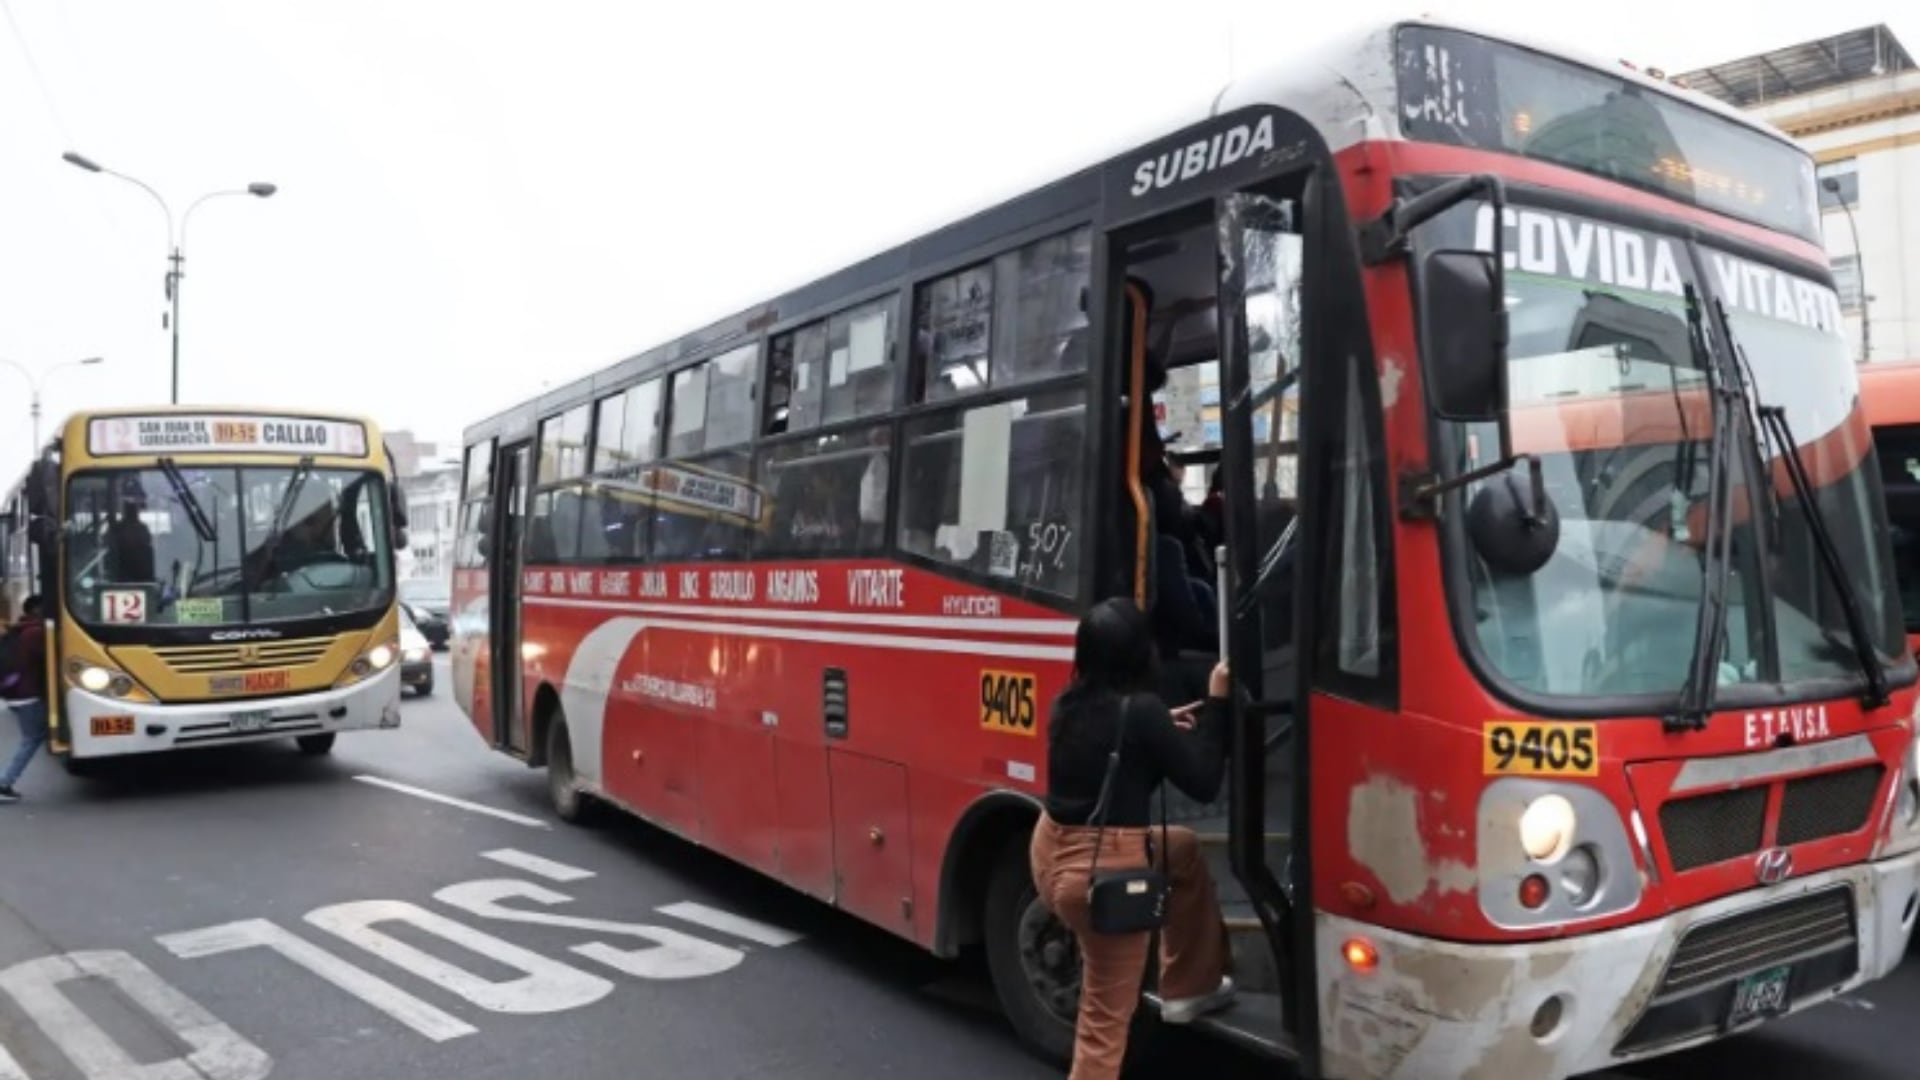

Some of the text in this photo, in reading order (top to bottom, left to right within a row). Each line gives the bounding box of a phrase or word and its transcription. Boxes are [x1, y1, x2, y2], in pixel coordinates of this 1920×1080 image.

[1131, 114, 1274, 197] SUBIDA
[1474, 203, 1687, 296] COVIDA
[138, 421, 162, 433] SAN
[165, 421, 190, 433] JUAN
[263, 422, 327, 445] CALLAO
[1028, 522, 1072, 570] 50%
[105, 594, 141, 622] 12
[848, 568, 904, 607] VITARTE
[981, 673, 1034, 729] 9405
[1490, 727, 1594, 772] 9405
